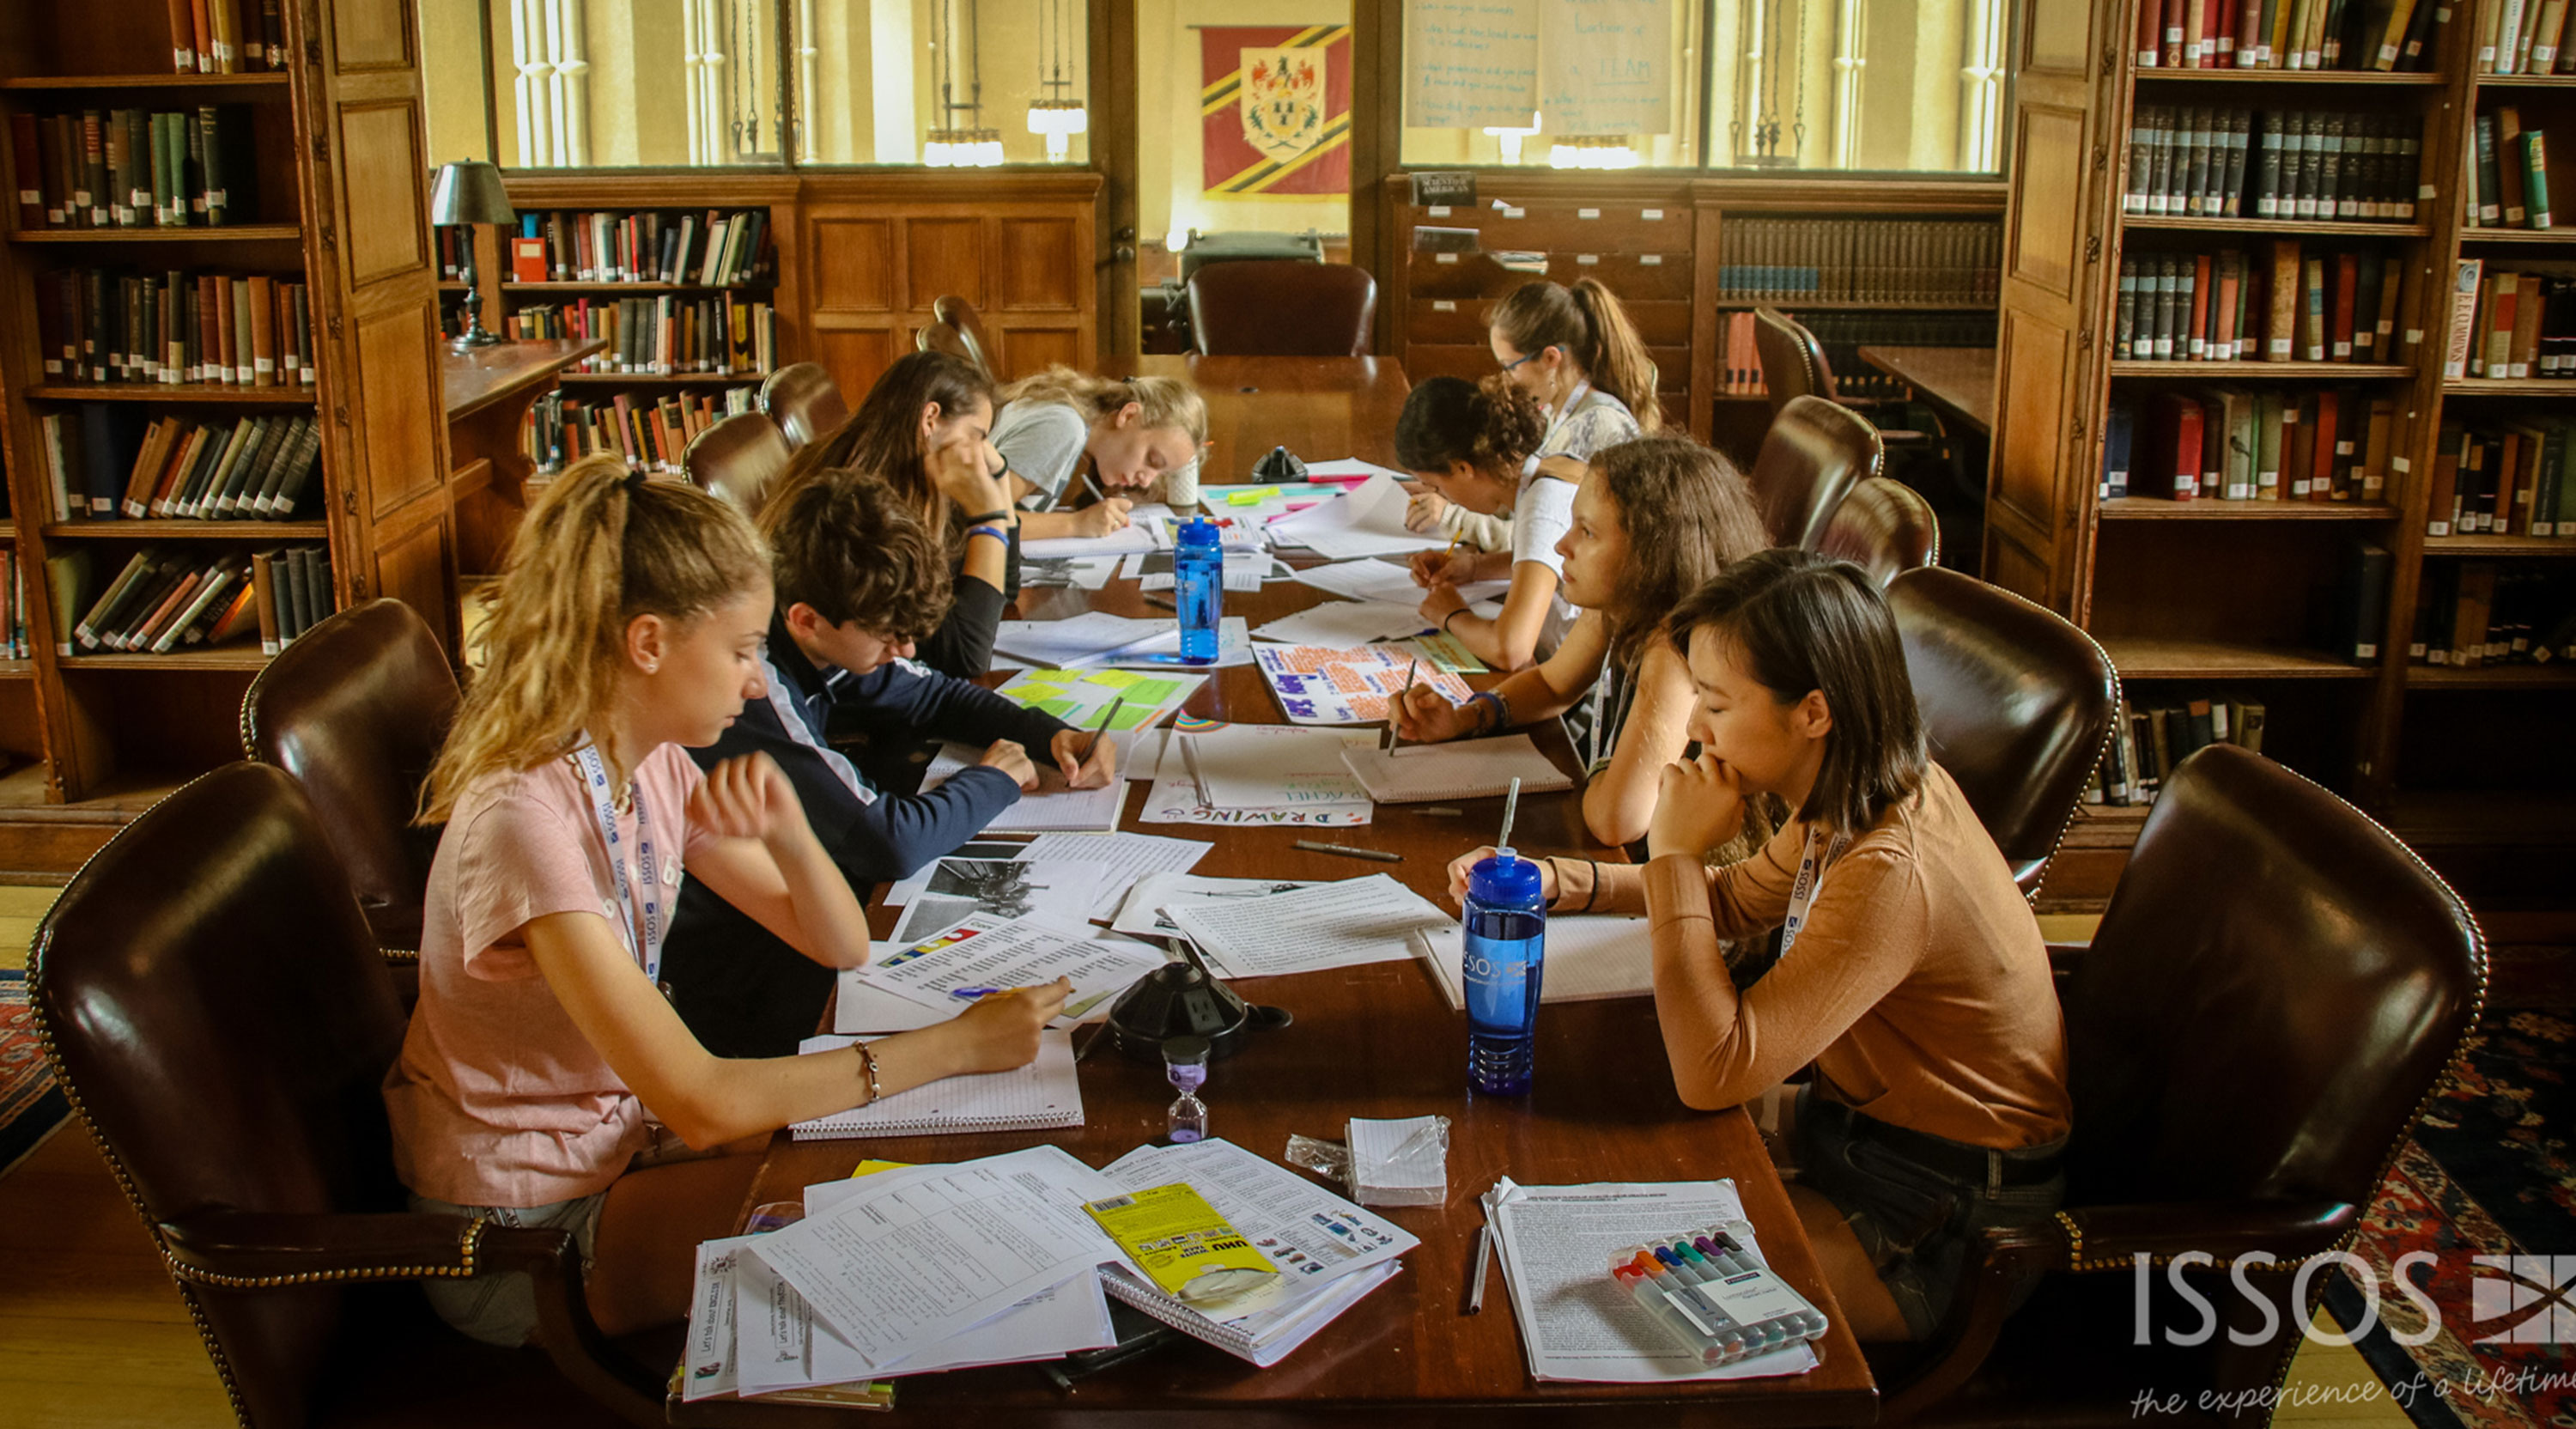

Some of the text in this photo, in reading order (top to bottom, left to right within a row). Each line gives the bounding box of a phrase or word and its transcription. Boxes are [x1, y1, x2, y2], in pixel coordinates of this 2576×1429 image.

[1423, 184, 1470, 195] AMERICAN
[601, 802, 617, 831] ISSOS
[1192, 809, 1332, 824] DRAWING
[641, 854, 653, 885] ISSOS
[1794, 871, 1810, 900] ISSOS
[646, 915, 657, 946] ISSOS
[1212, 1239, 1249, 1251] UHU
[707, 1310, 716, 1325] about
